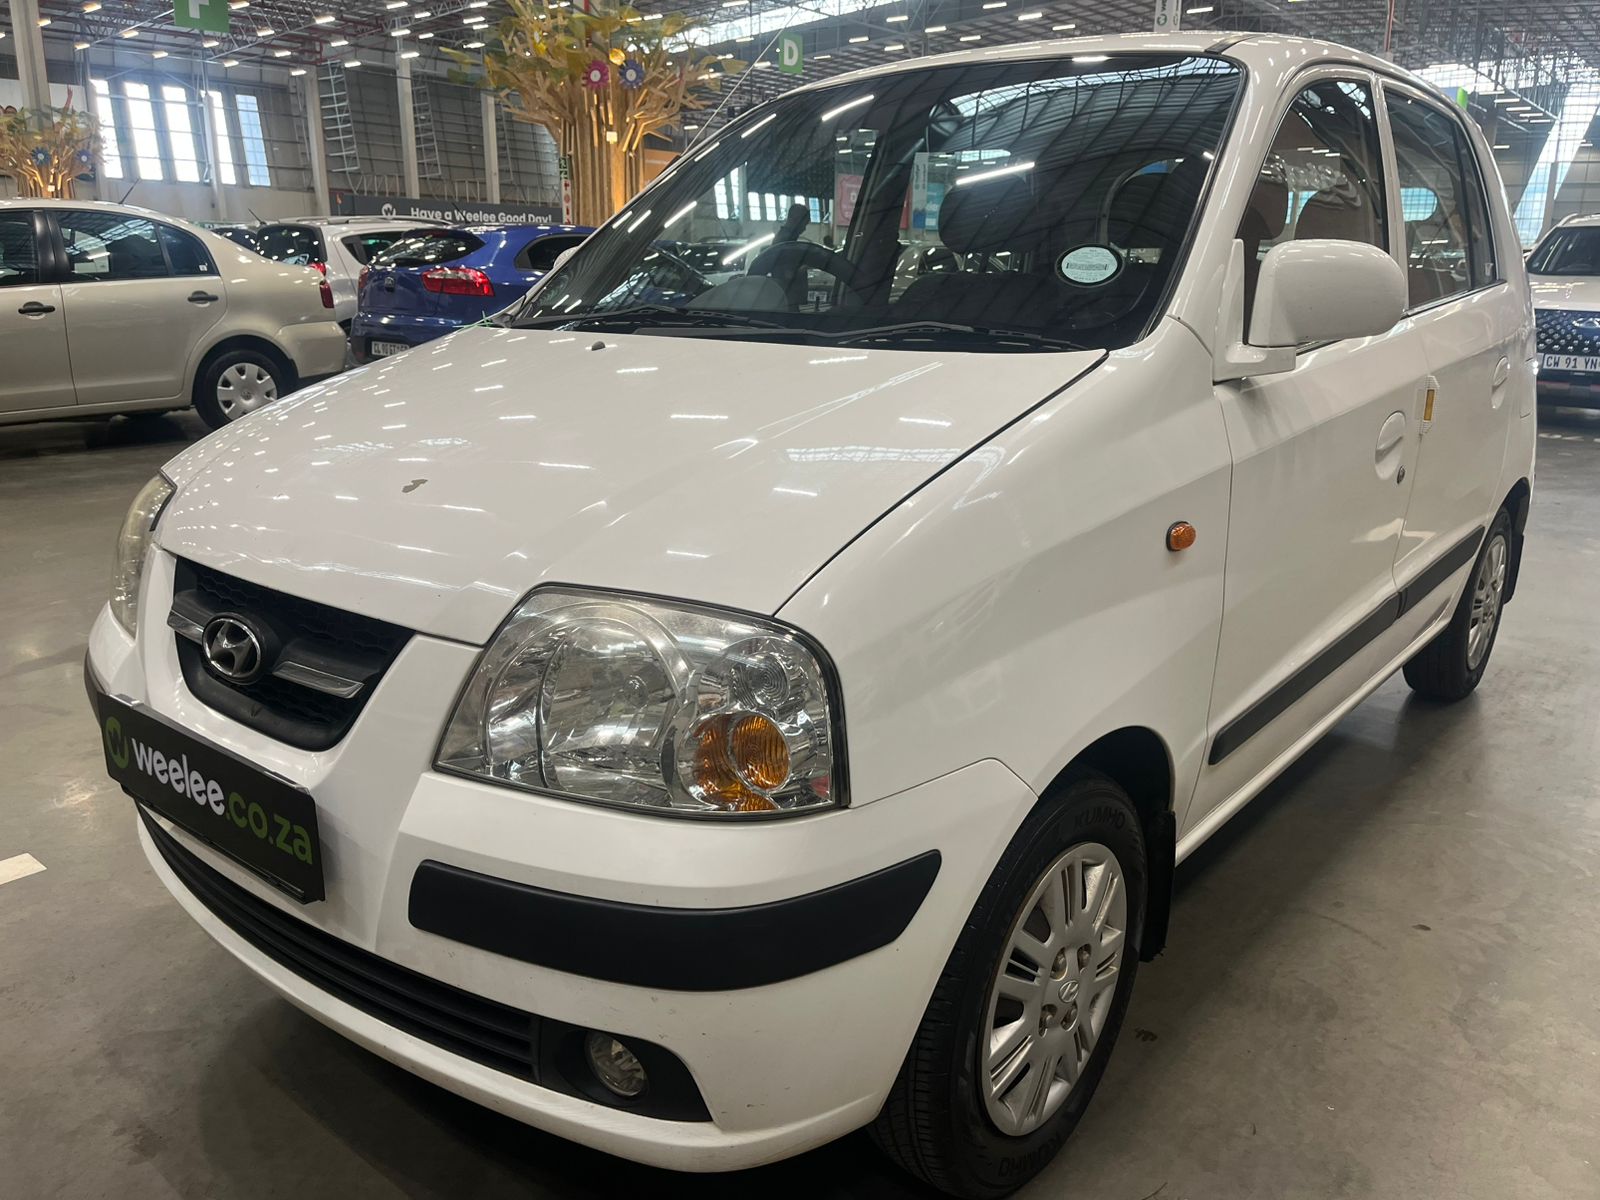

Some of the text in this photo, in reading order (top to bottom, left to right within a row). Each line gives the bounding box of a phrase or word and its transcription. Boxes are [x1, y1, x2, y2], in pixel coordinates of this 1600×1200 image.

[783, 38, 799, 66] D
[410, 207, 552, 223] Have a Weelee Good Day!
[1546, 356, 1598, 370] CW 91 YN
[132, 737, 313, 865] weelee.co.za
